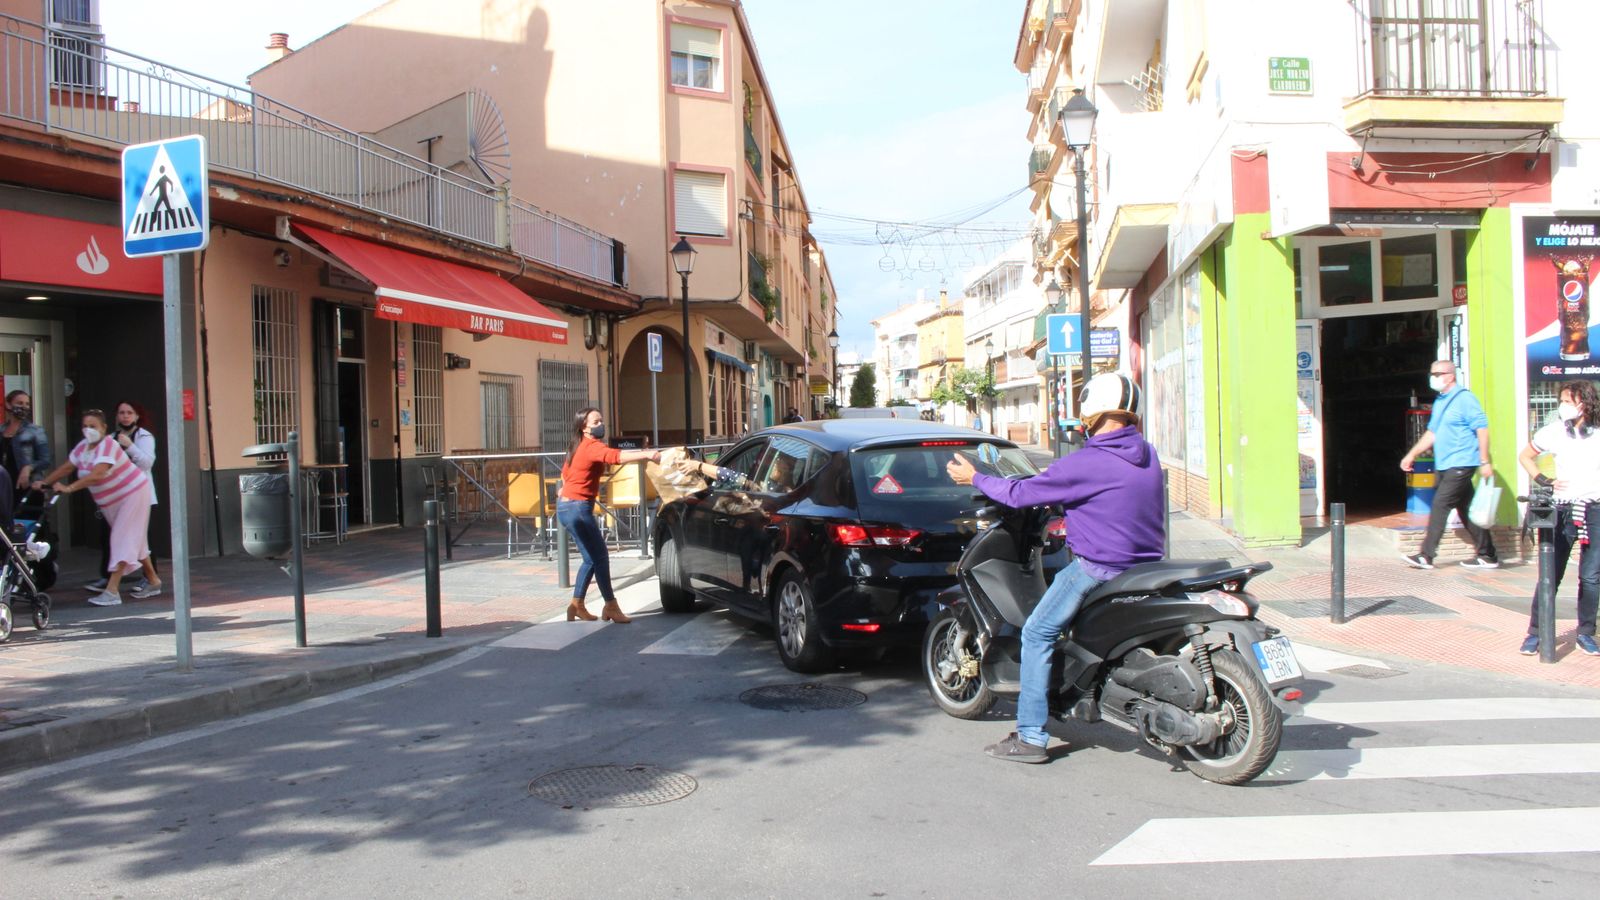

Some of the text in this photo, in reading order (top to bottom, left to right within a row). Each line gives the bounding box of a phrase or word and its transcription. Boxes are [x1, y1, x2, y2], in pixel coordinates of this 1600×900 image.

[1282, 59, 1300, 68] Calle
[1548, 220, 1595, 236] MÓJATE
[1535, 237, 1542, 246] Y
[1542, 237, 1567, 246] ELIGE
[1567, 237, 1579, 246] LO
[470, 315, 504, 333] BAR PARIS
[1270, 658, 1293, 678] LBN
